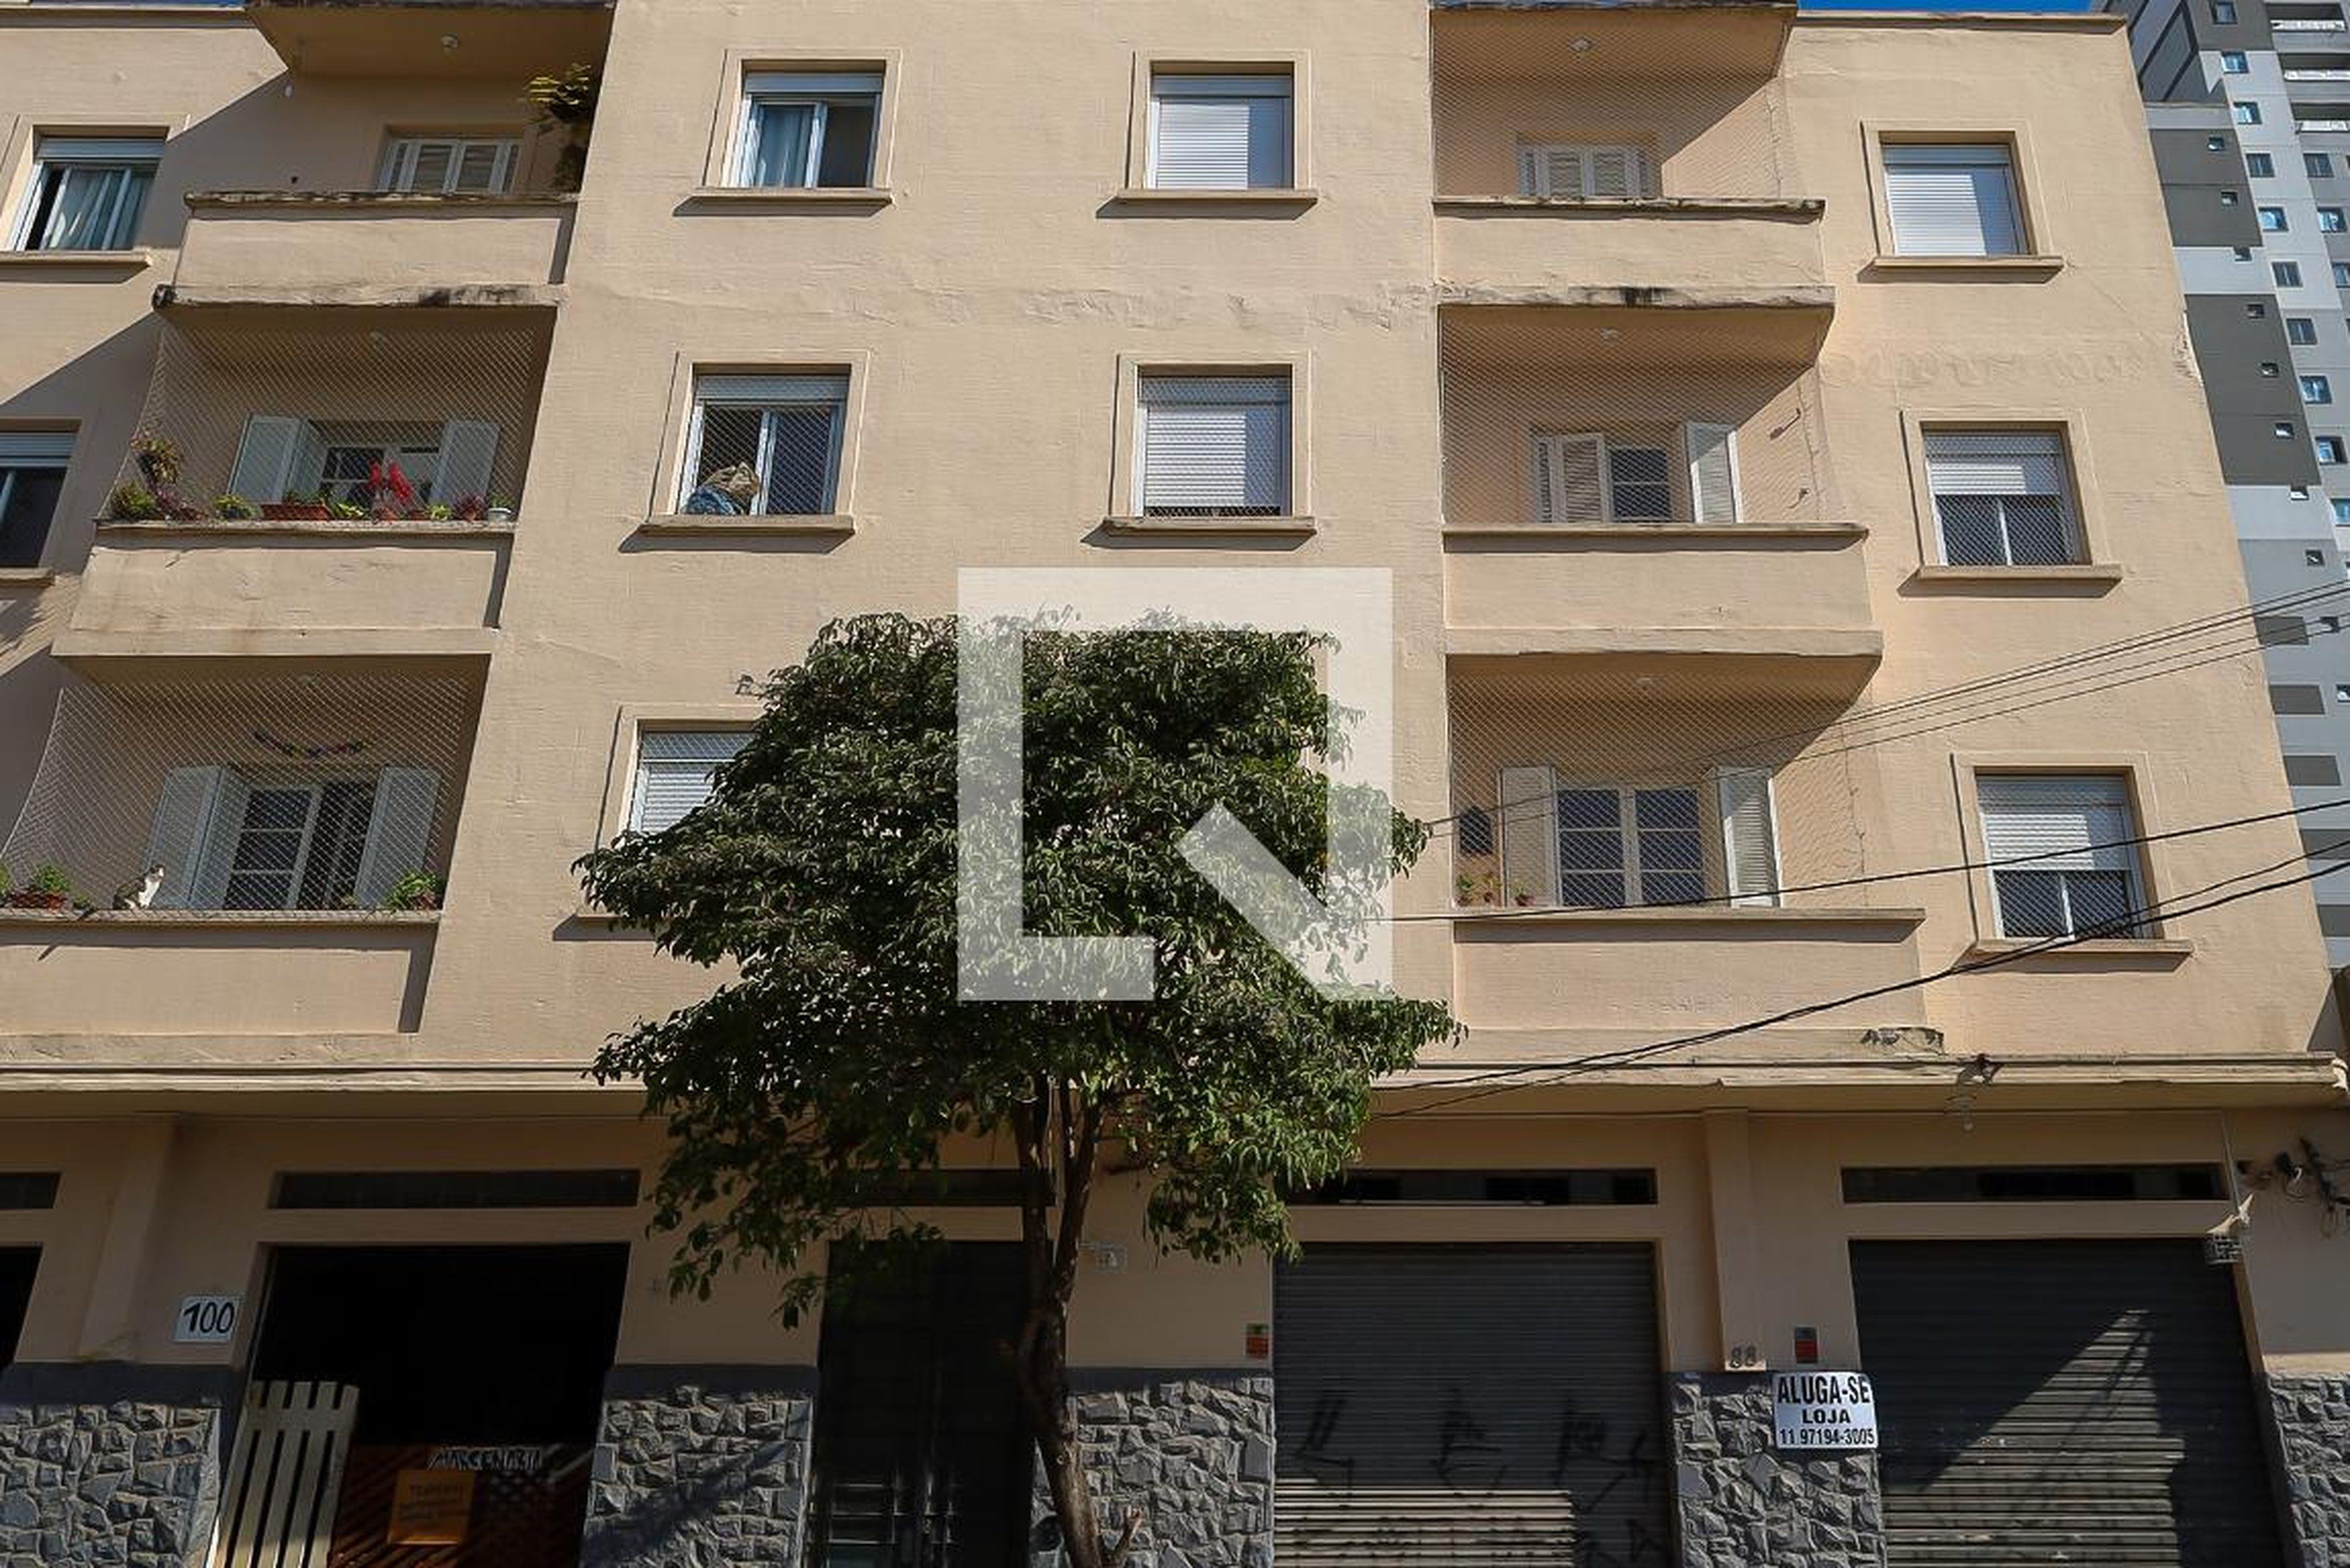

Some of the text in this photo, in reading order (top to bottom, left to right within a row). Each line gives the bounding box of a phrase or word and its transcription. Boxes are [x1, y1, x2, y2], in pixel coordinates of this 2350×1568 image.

[184, 1302, 234, 1334] 100
[1729, 1345, 1757, 1368] 88
[1777, 1375, 1870, 1405] ALUGA-SE
[1802, 1408, 1851, 1424] LOJA
[1780, 1428, 1874, 1445] 11 97194-3005
